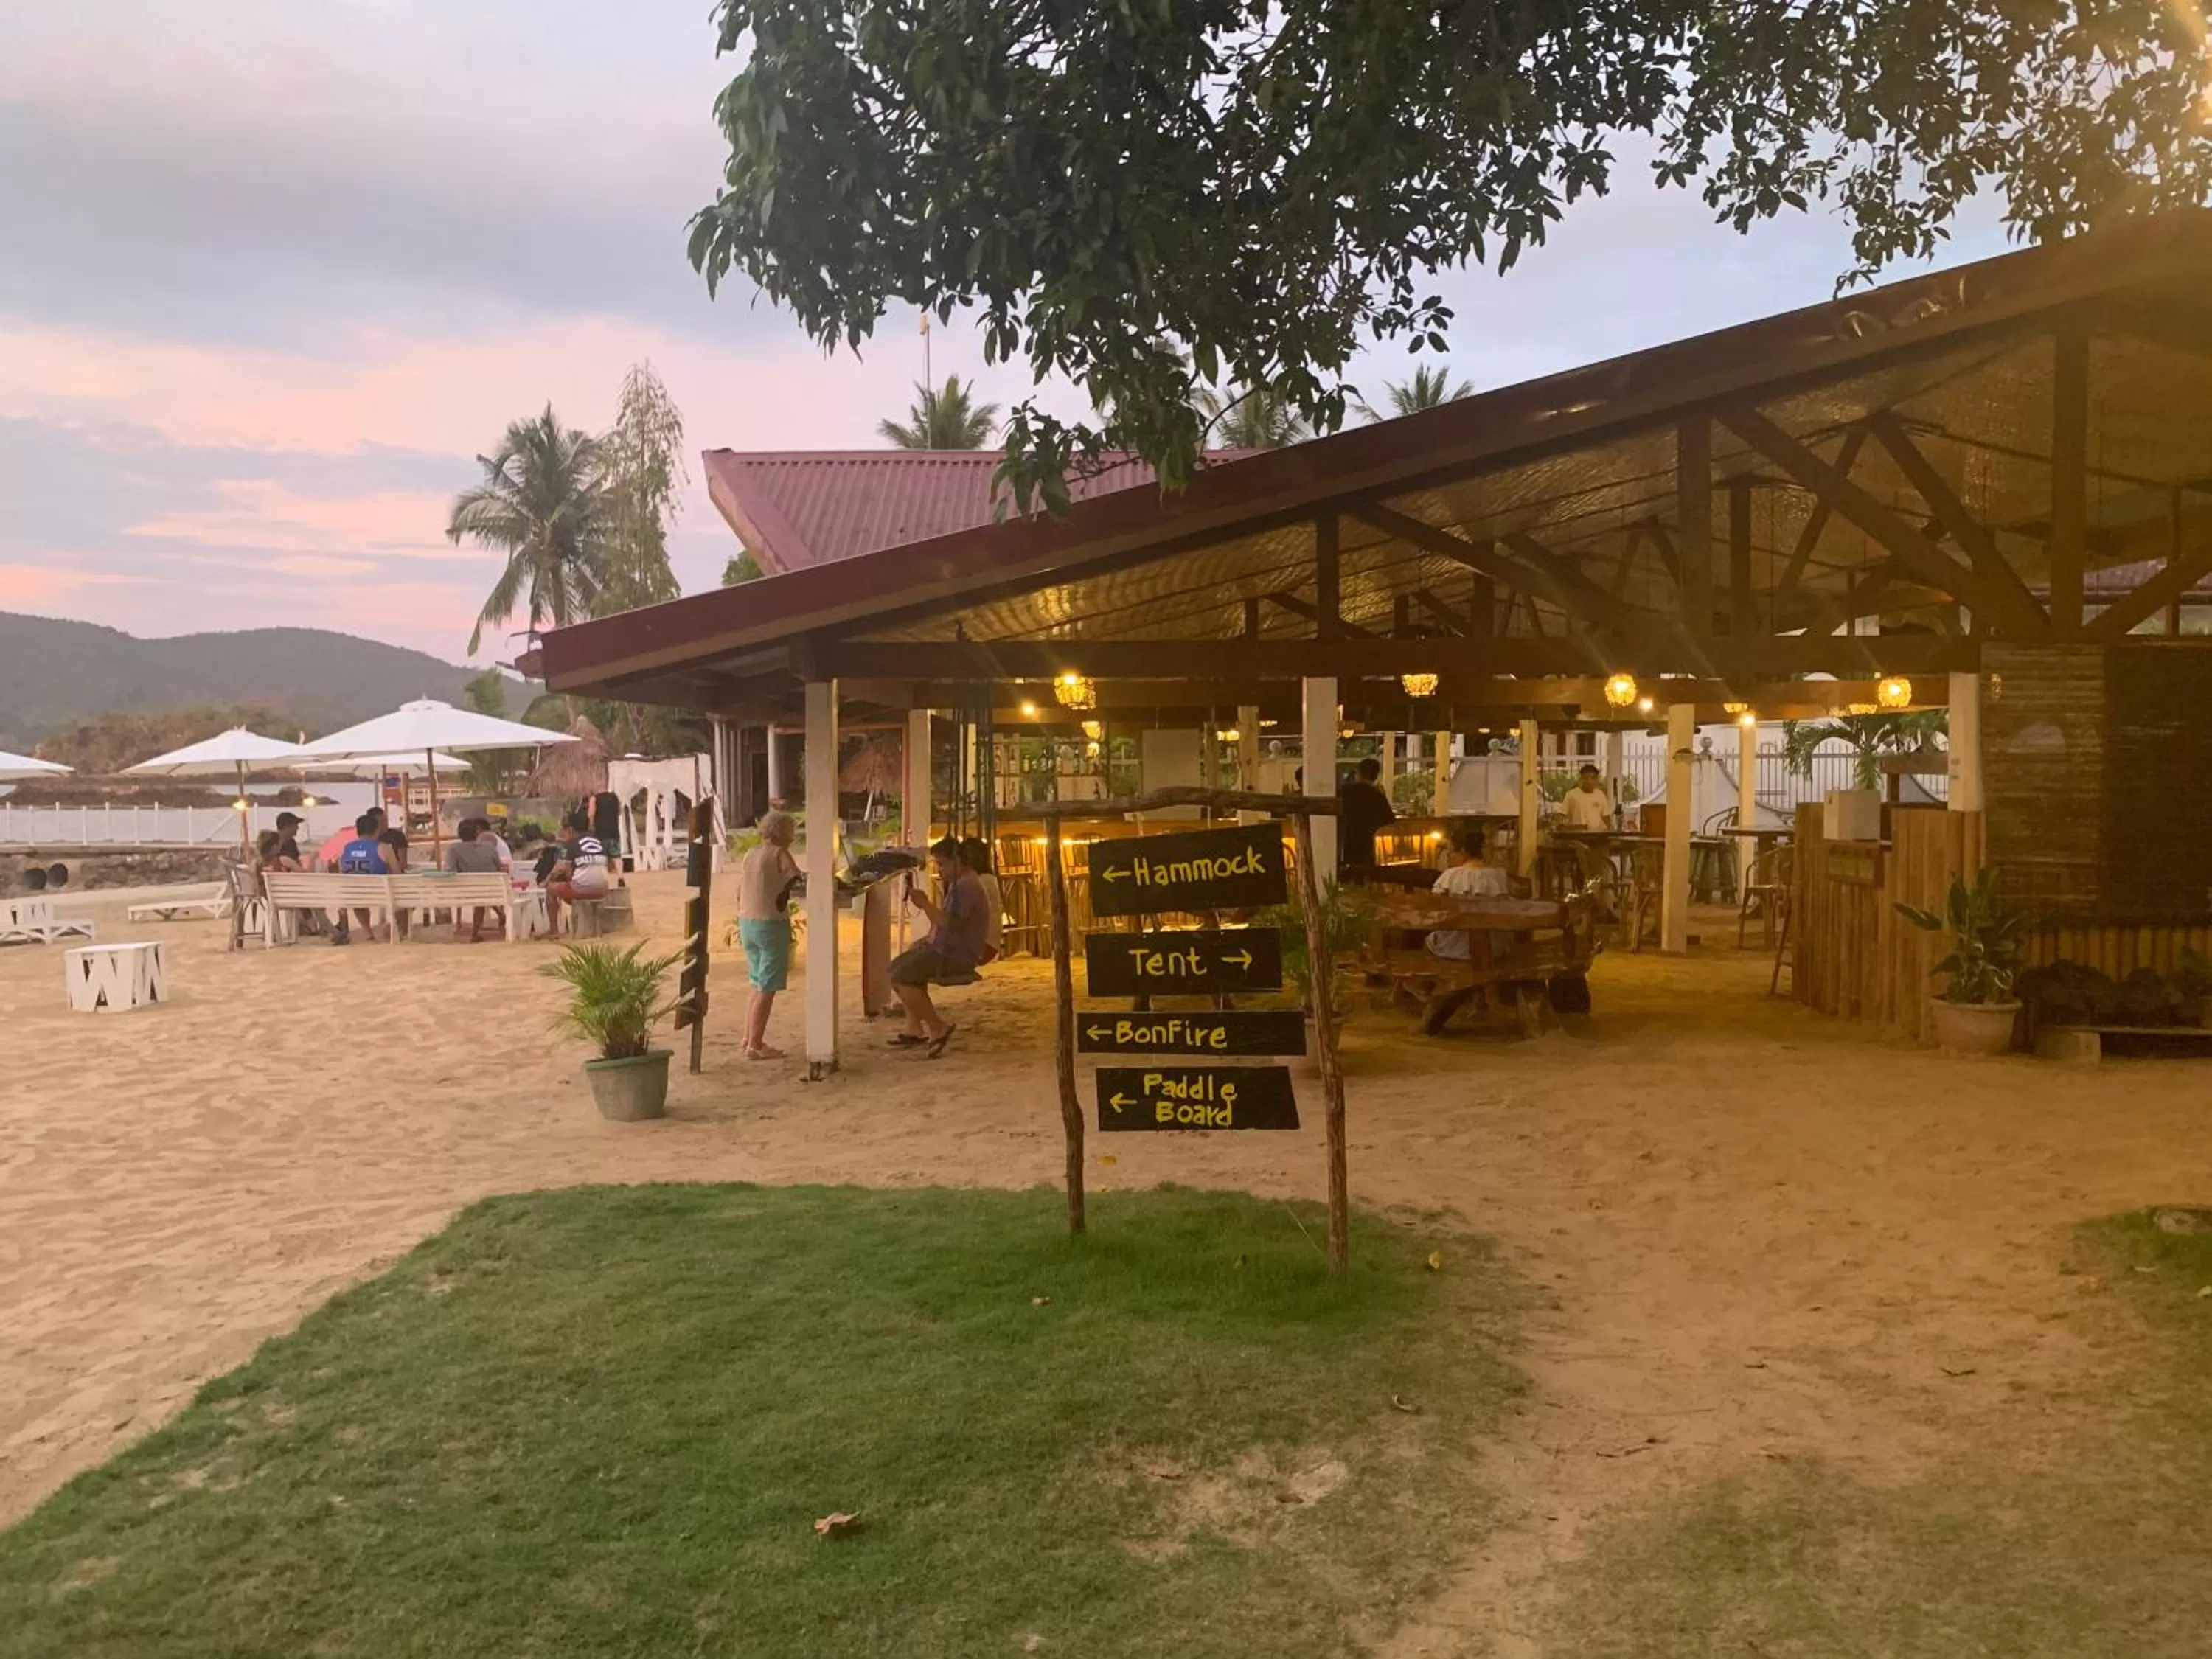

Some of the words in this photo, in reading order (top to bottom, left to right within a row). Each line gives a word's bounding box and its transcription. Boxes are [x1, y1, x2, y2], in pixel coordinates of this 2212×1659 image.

[1133, 846, 1266, 886] Hammock
[1128, 947, 1208, 976] Tent
[1144, 1073, 1238, 1101] Paddle
[1155, 1099, 1233, 1127] Board
